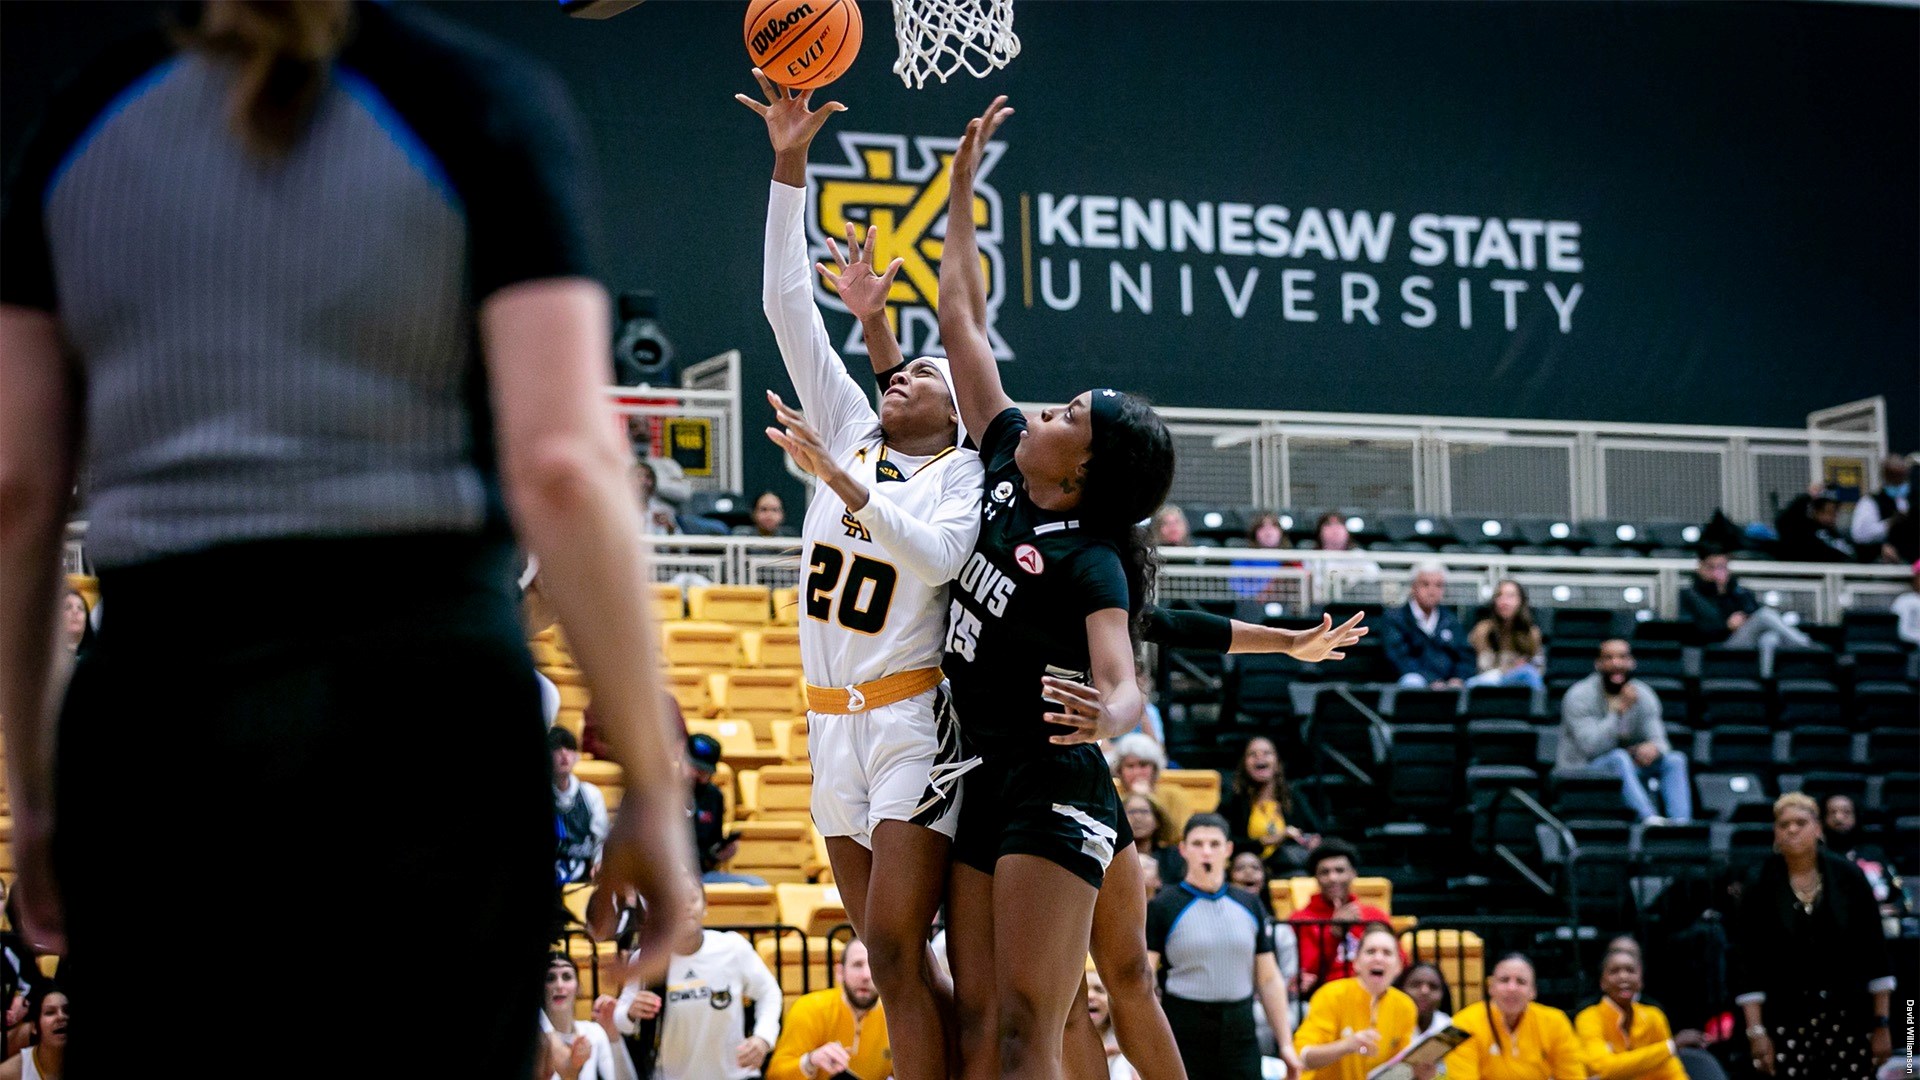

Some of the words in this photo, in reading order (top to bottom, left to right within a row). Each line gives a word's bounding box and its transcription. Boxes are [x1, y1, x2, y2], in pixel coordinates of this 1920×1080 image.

[751, 3, 814, 56] Wilson
[1038, 193, 1395, 263] KENNESAW
[1408, 213, 1584, 273] STATE
[1040, 257, 1584, 333] UNIVERSITY
[806, 540, 899, 637] 20
[960, 551, 1017, 618] OVS
[945, 598, 983, 663] 15
